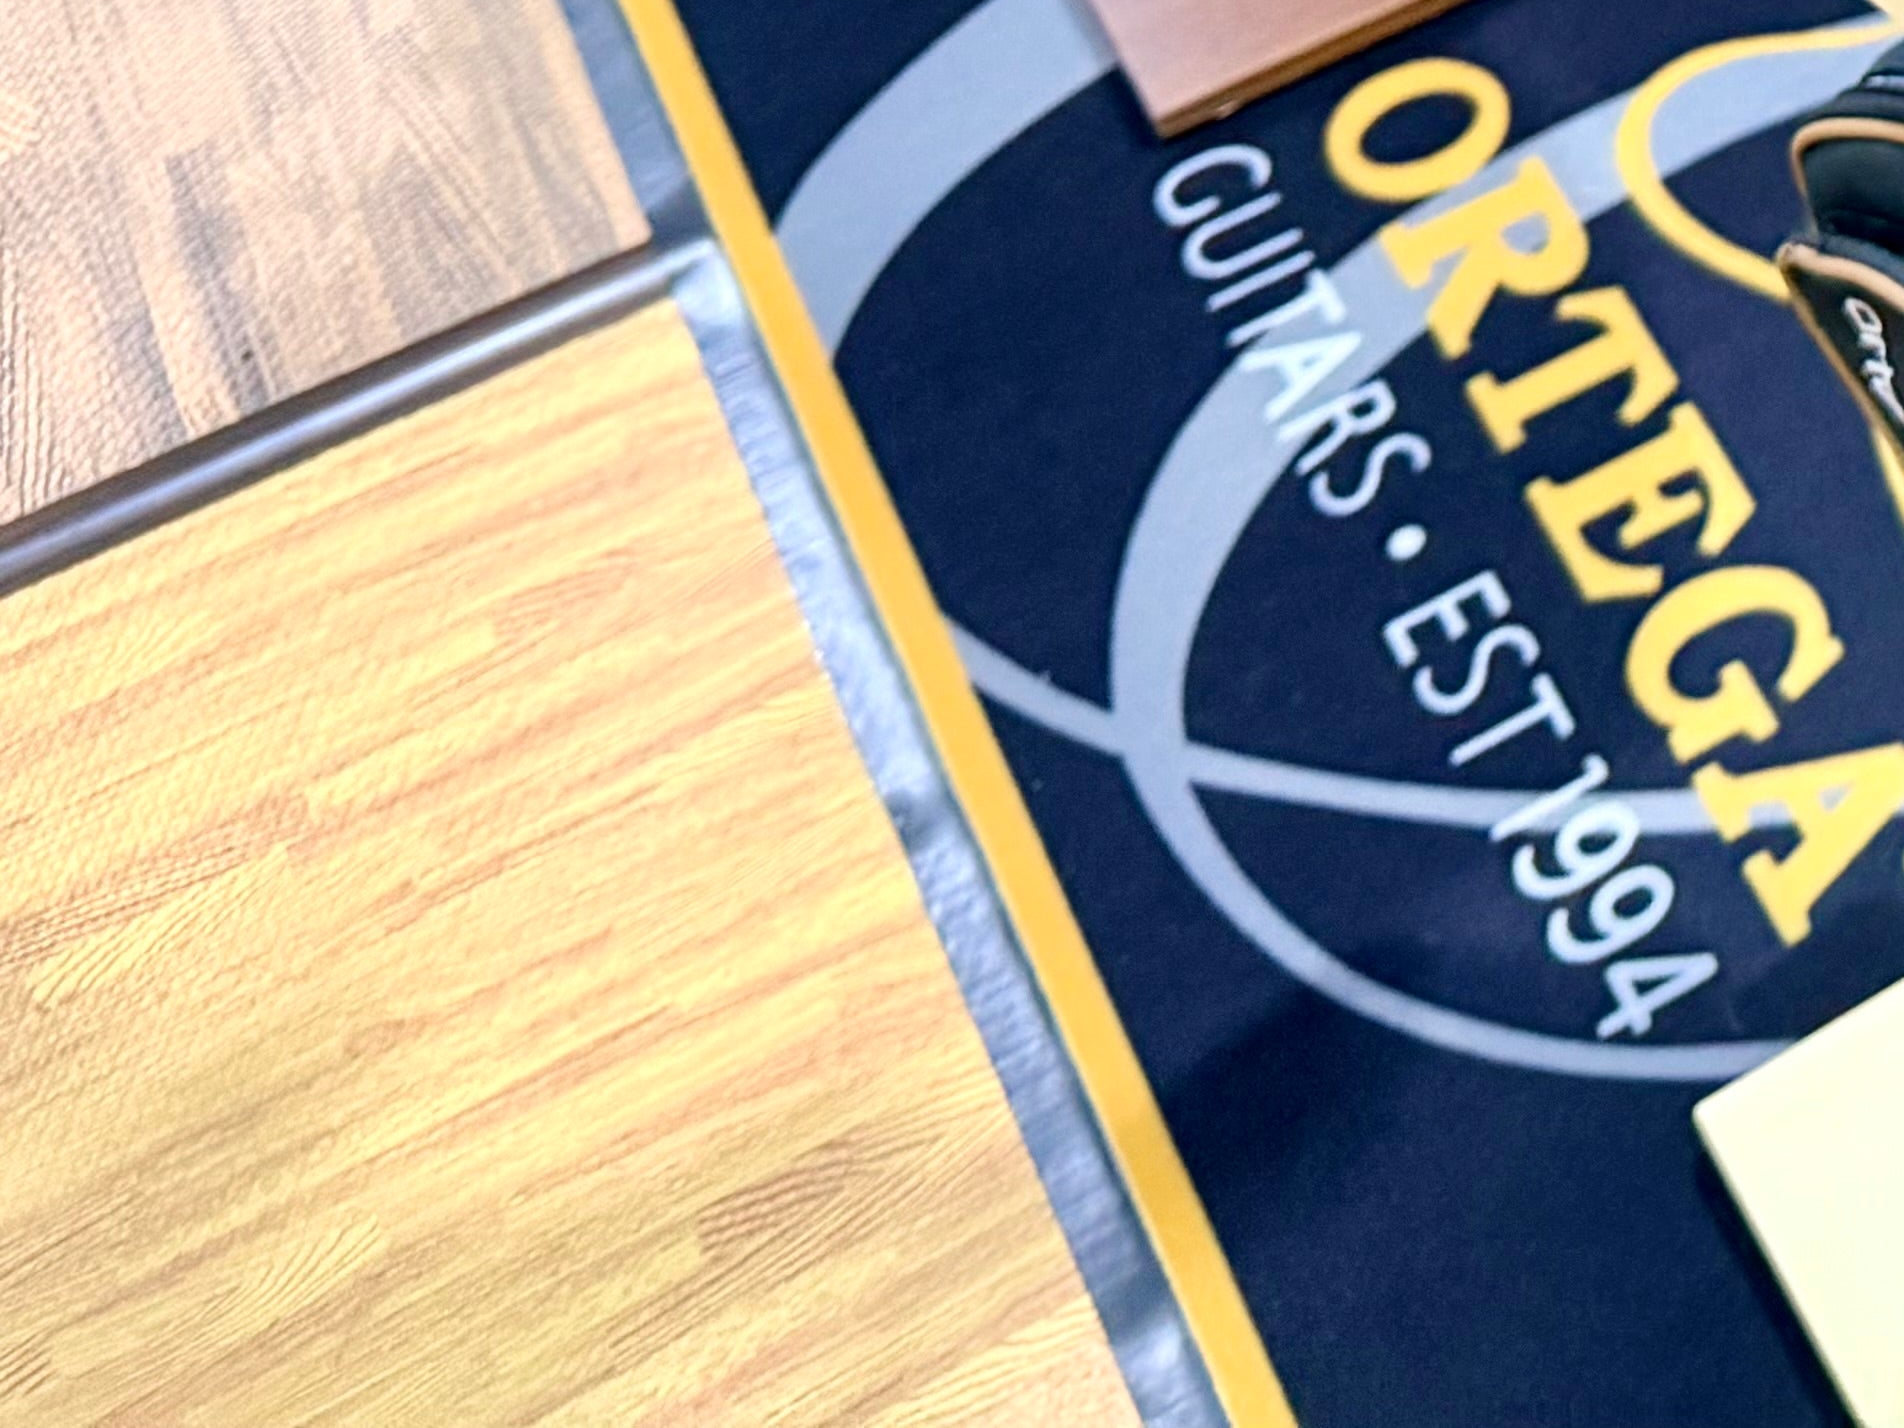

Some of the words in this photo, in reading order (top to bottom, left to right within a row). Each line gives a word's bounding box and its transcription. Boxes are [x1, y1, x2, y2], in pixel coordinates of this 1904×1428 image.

[1152, 142, 1433, 517] GUITARS
[1381, 569, 1576, 769] EST
[1489, 754, 1719, 1040] 1994
